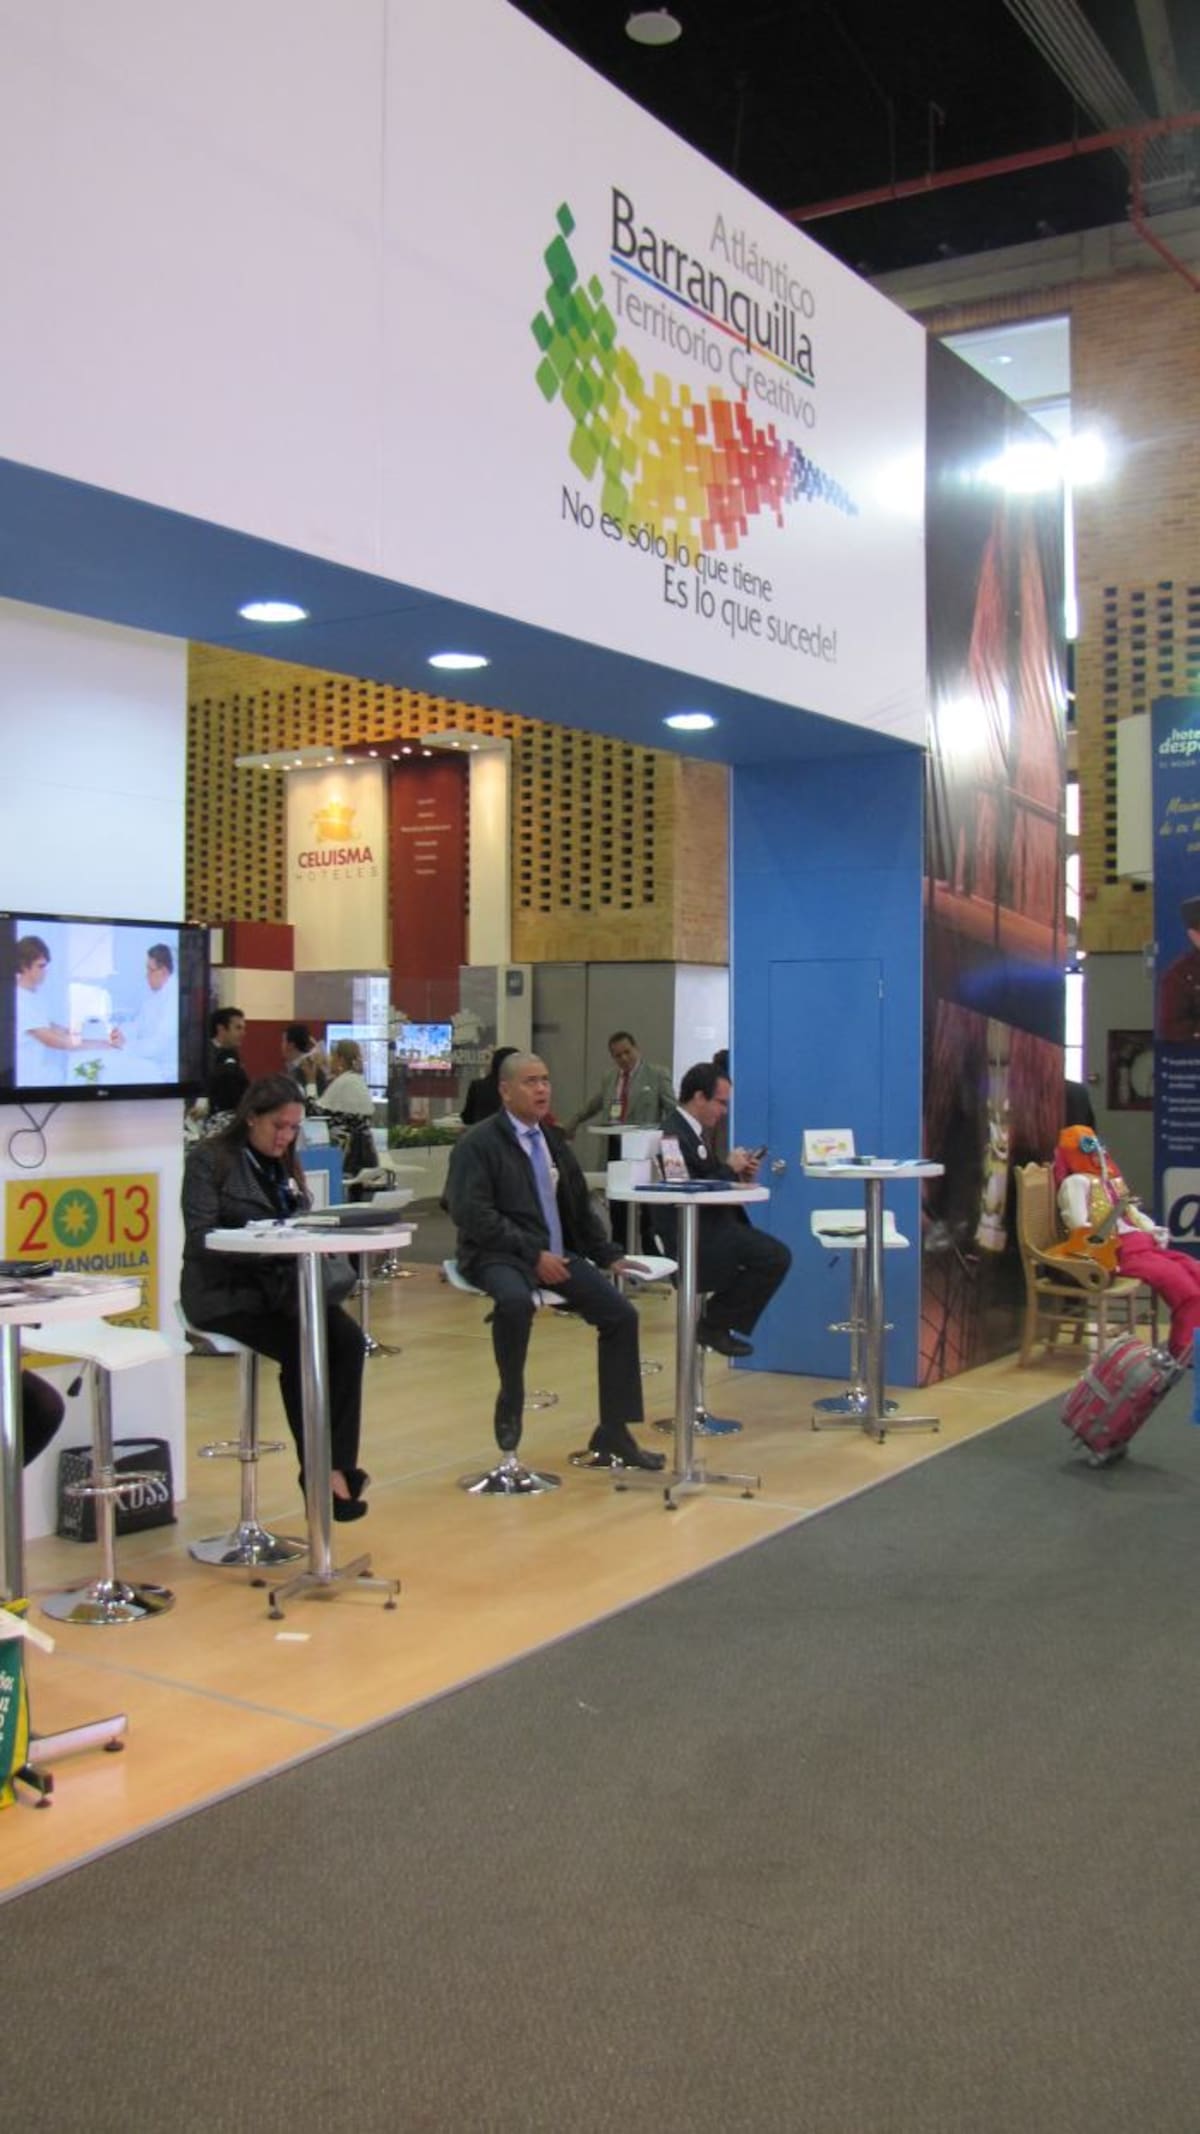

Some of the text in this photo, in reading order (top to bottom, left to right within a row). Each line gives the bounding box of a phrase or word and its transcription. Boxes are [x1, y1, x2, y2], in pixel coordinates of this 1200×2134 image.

[612, 186, 814, 379] Barranquilla
[710, 213, 815, 320] Atlántico
[611, 271, 815, 429] Territorio Creativo
[562, 485, 772, 602] No es sólo lo que tiene
[664, 564, 837, 663] Es lo que sucede!
[297, 846, 373, 869] CELUISMA
[18, 1184, 150, 1252] 2013
[51, 1250, 149, 1272] RANQUILLA
